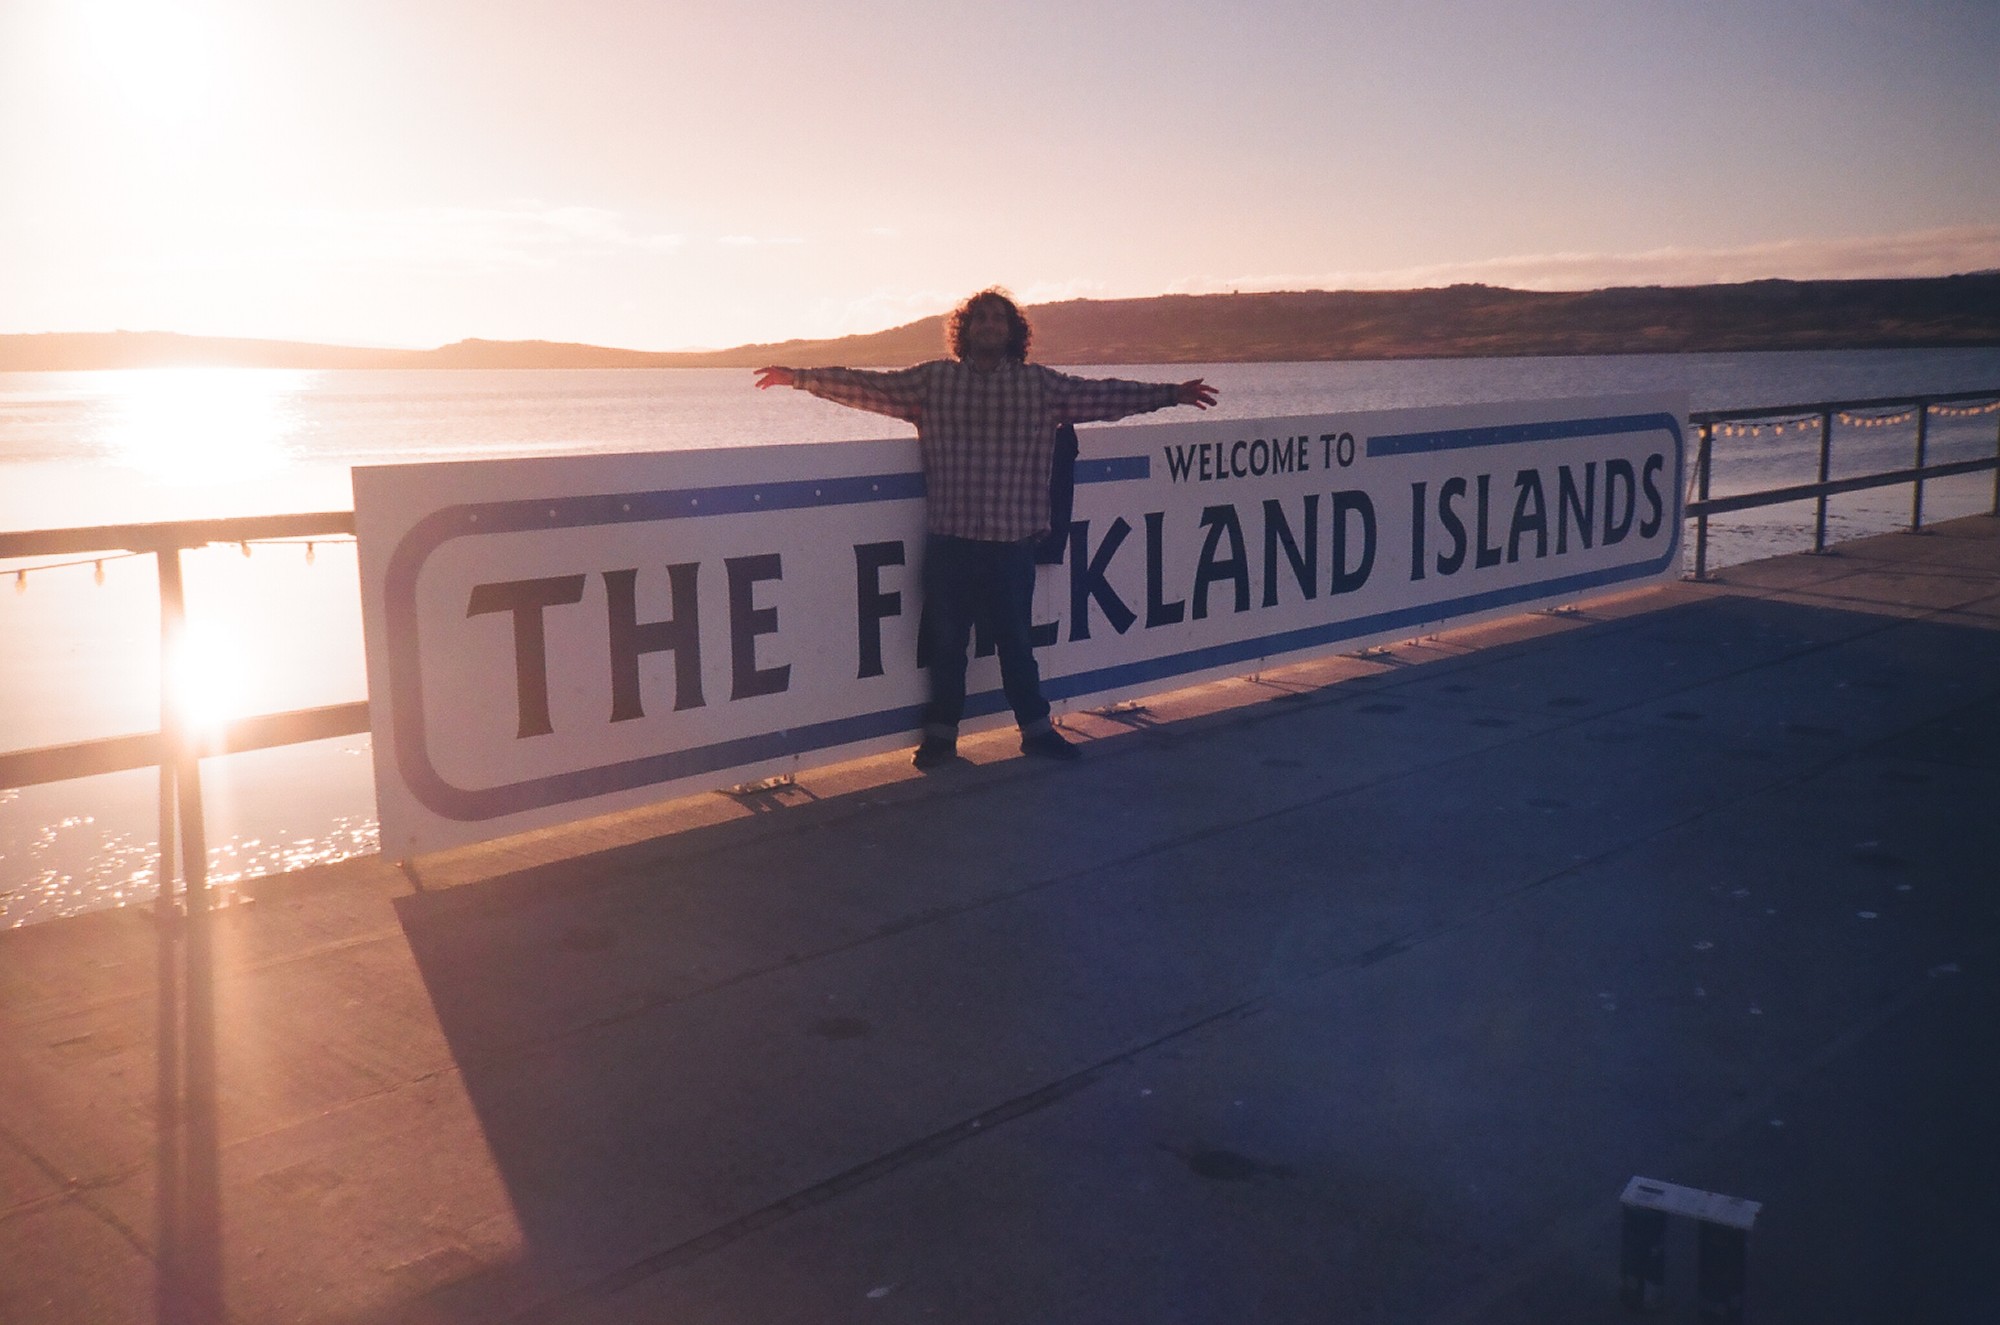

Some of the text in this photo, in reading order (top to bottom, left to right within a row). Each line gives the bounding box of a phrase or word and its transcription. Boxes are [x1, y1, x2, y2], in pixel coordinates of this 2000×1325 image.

[1164, 432, 1355, 483] WELCOME TO
[465, 453, 1665, 740] THE FKLAND ISLANDS
